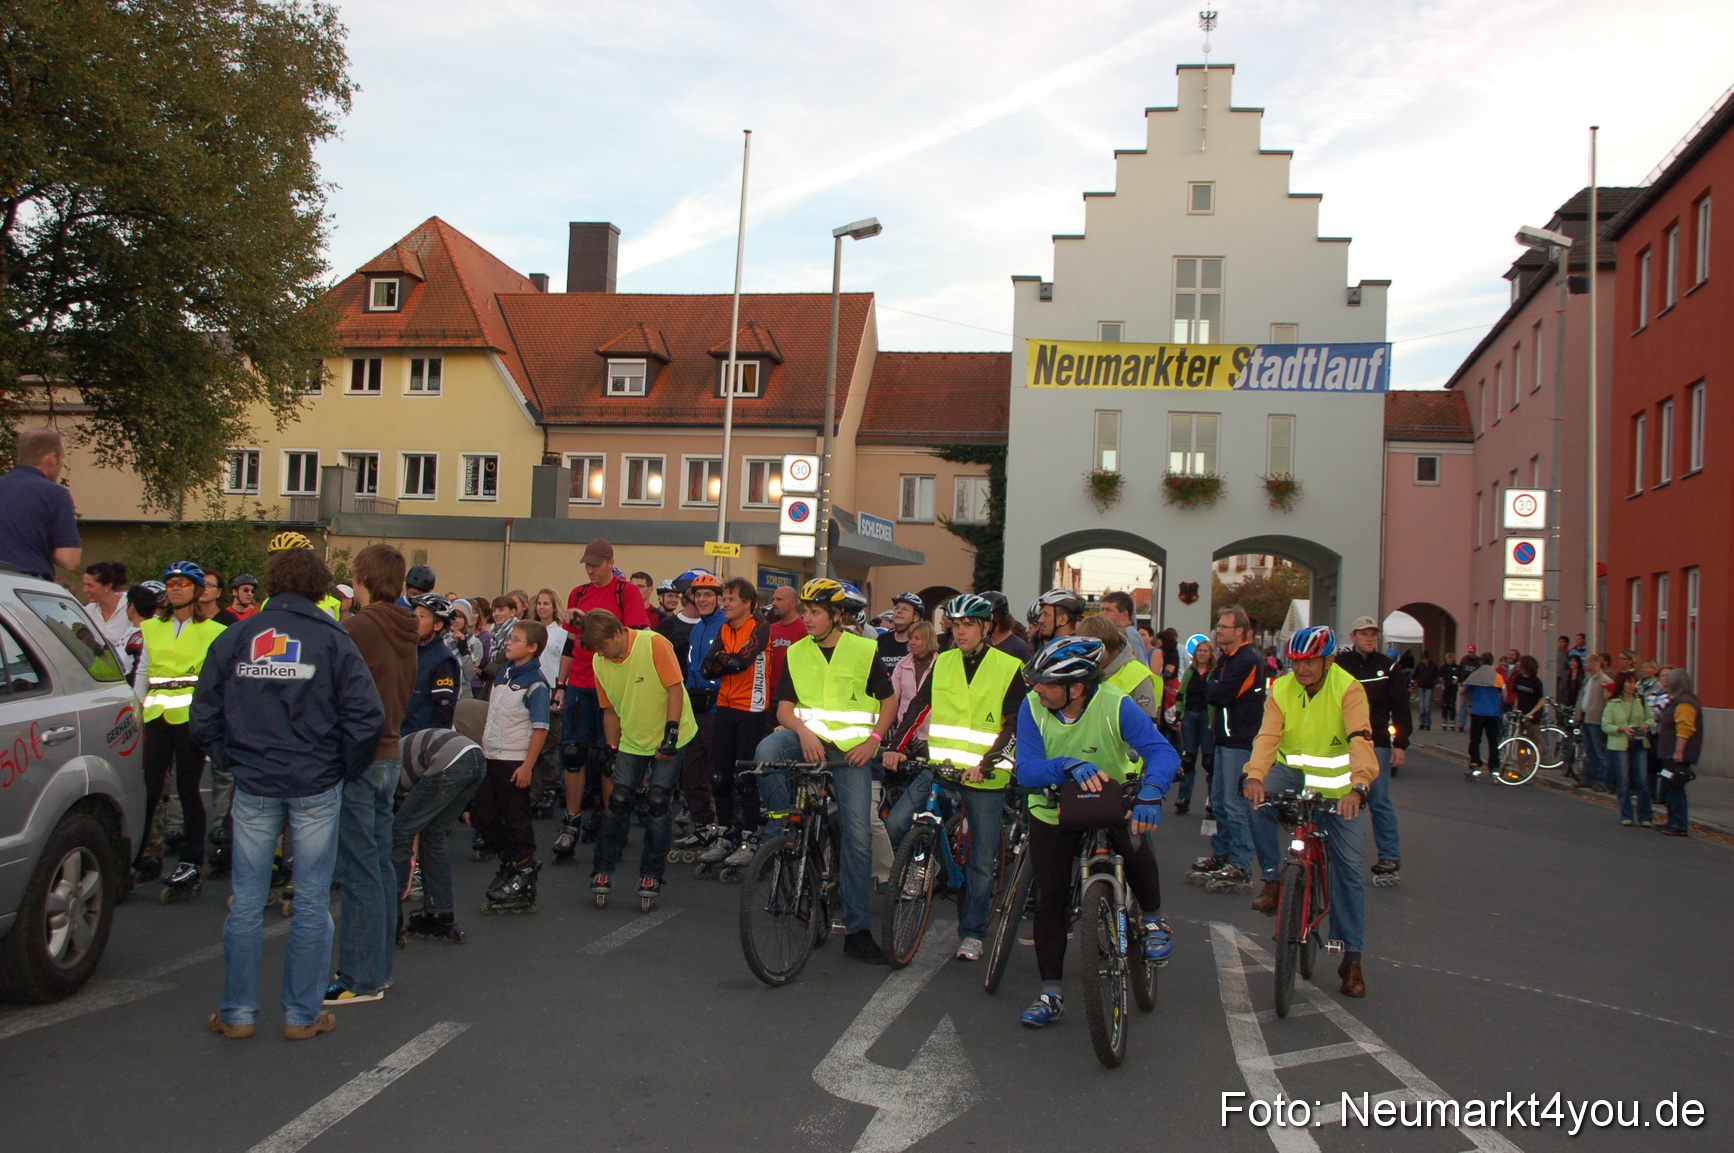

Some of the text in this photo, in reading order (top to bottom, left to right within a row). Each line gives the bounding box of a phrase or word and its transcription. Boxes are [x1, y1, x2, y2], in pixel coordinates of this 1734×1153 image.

[1033, 345, 1384, 391] Neumarkter Stadtlauf
[794, 465, 808, 475] 30
[1518, 500, 1532, 511] 30
[861, 518, 893, 542] SCHLECKER
